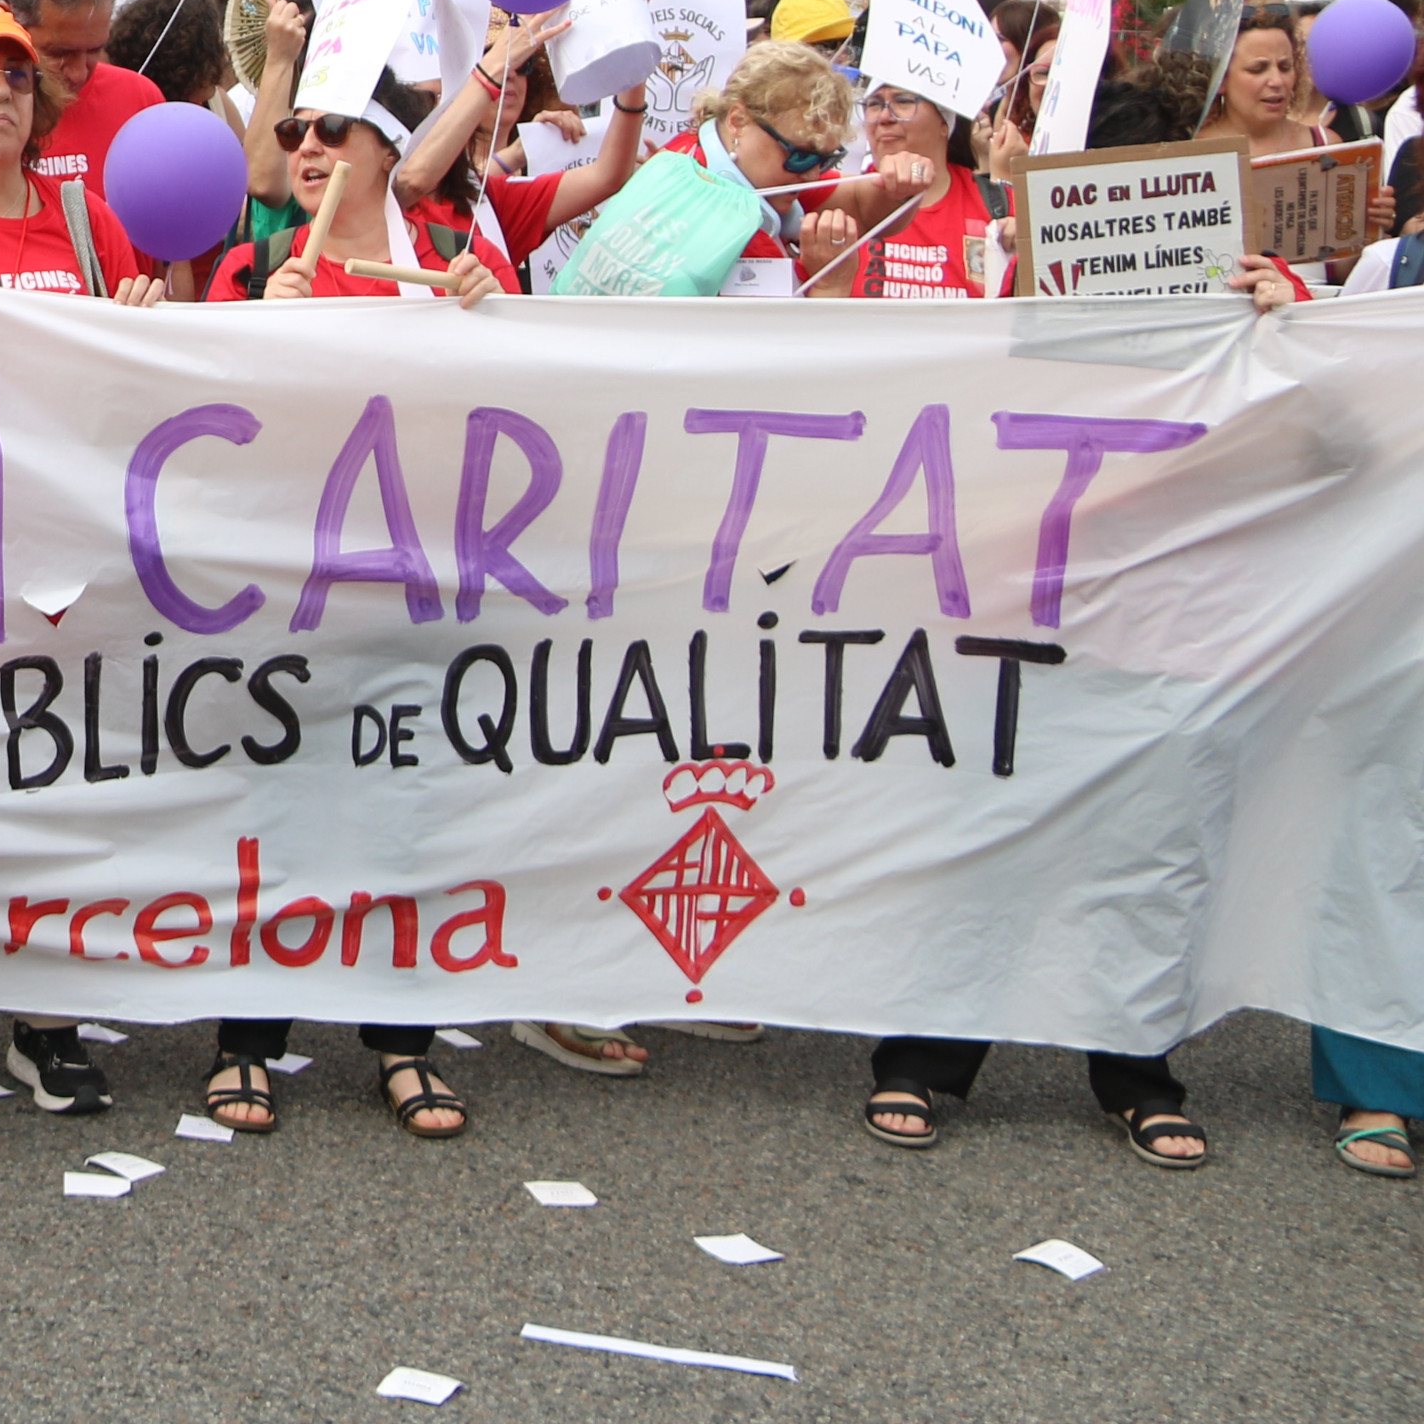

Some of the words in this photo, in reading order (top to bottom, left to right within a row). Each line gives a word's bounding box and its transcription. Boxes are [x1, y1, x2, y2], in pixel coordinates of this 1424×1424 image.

[678, 8, 726, 42] SOCIALS
[912, 16, 941, 38] AL
[895, 20, 963, 67] PAPA
[1051, 183, 1098, 209] OAC
[1107, 185, 1131, 202] EN
[1140, 170, 1217, 200] LLUITA
[1274, 186, 1285, 198] LES
[1040, 214, 1157, 245] NOSALTRES
[1163, 200, 1232, 231] TAMBÉ
[1285, 212, 1295, 229] PAGA
[1335, 173, 1358, 241] ATENCIÓ
[868, 238, 948, 262] OFICINES
[1273, 223, 1283, 249] SOCIALS
[1296, 221, 1307, 257] BARCELONA
[866, 257, 944, 282] ATENCIÓ
[1076, 252, 1137, 277] TENIM
[1144, 243, 1204, 270] LÍNIES
[863, 278, 968, 299] CIUTADANA
[124, 394, 1208, 635] CARITAT
[352, 703, 423, 769] DE
